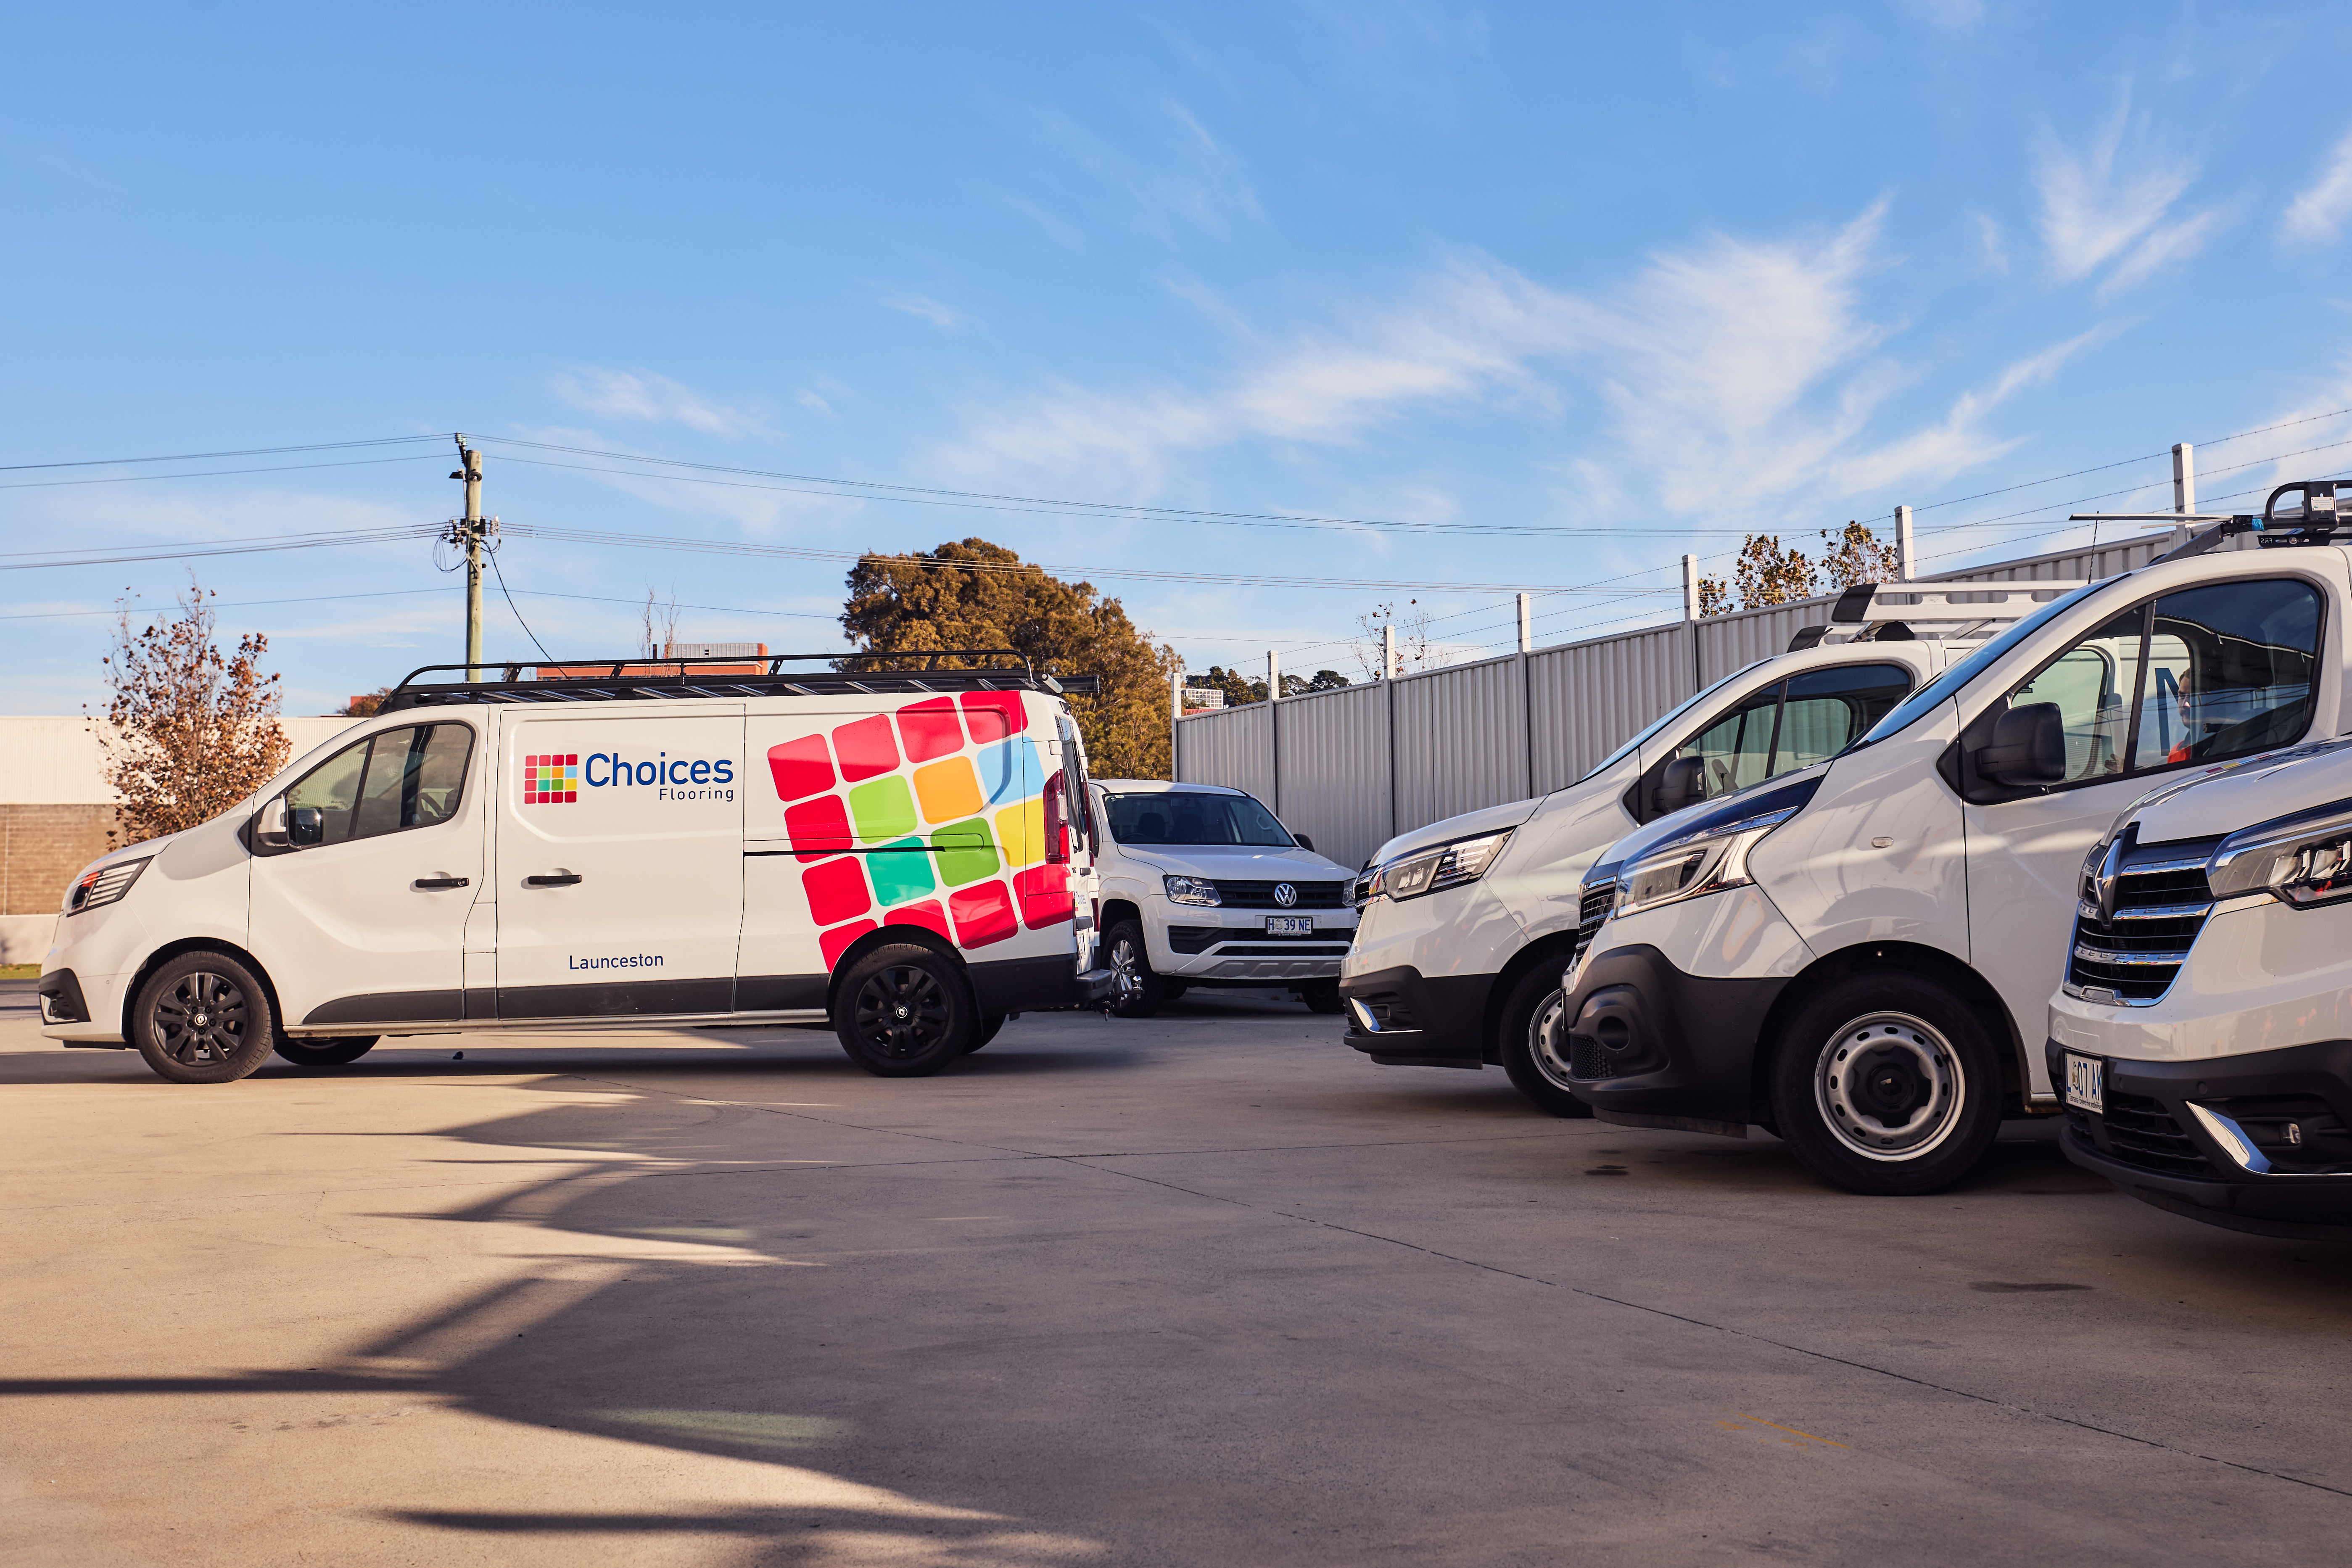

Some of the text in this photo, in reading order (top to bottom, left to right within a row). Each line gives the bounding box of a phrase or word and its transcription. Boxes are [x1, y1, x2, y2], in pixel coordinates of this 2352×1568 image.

[586, 752, 734, 787] Choices
[660, 787, 734, 802] Flooring
[1268, 919, 1311, 931] H 39 NE
[570, 953, 663, 970] Launceston
[2078, 1061, 2088, 1098] 07
